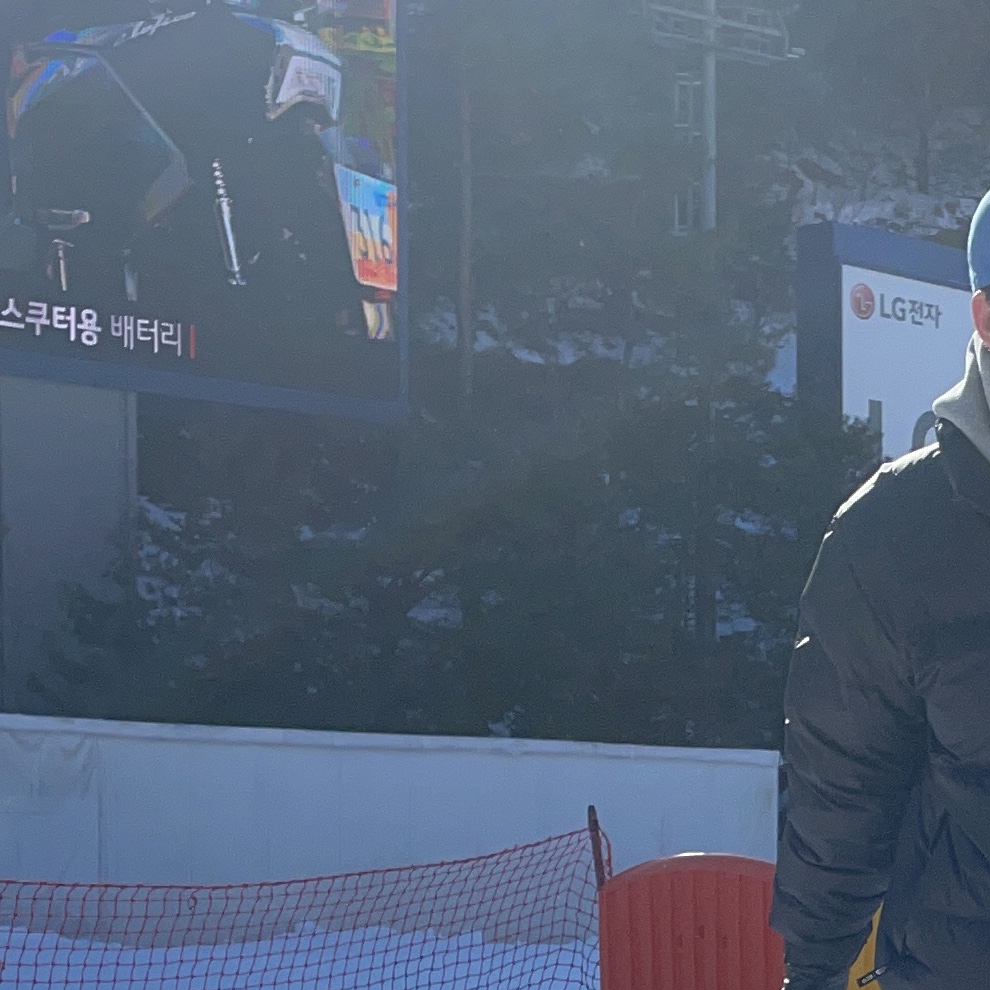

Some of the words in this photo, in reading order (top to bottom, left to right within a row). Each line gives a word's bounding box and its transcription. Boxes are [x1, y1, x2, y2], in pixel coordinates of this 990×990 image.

[0, 298, 102, 346] 스쿠터용
[110, 314, 183, 358] 배터리
[880, 293, 943, 330] LG전자
